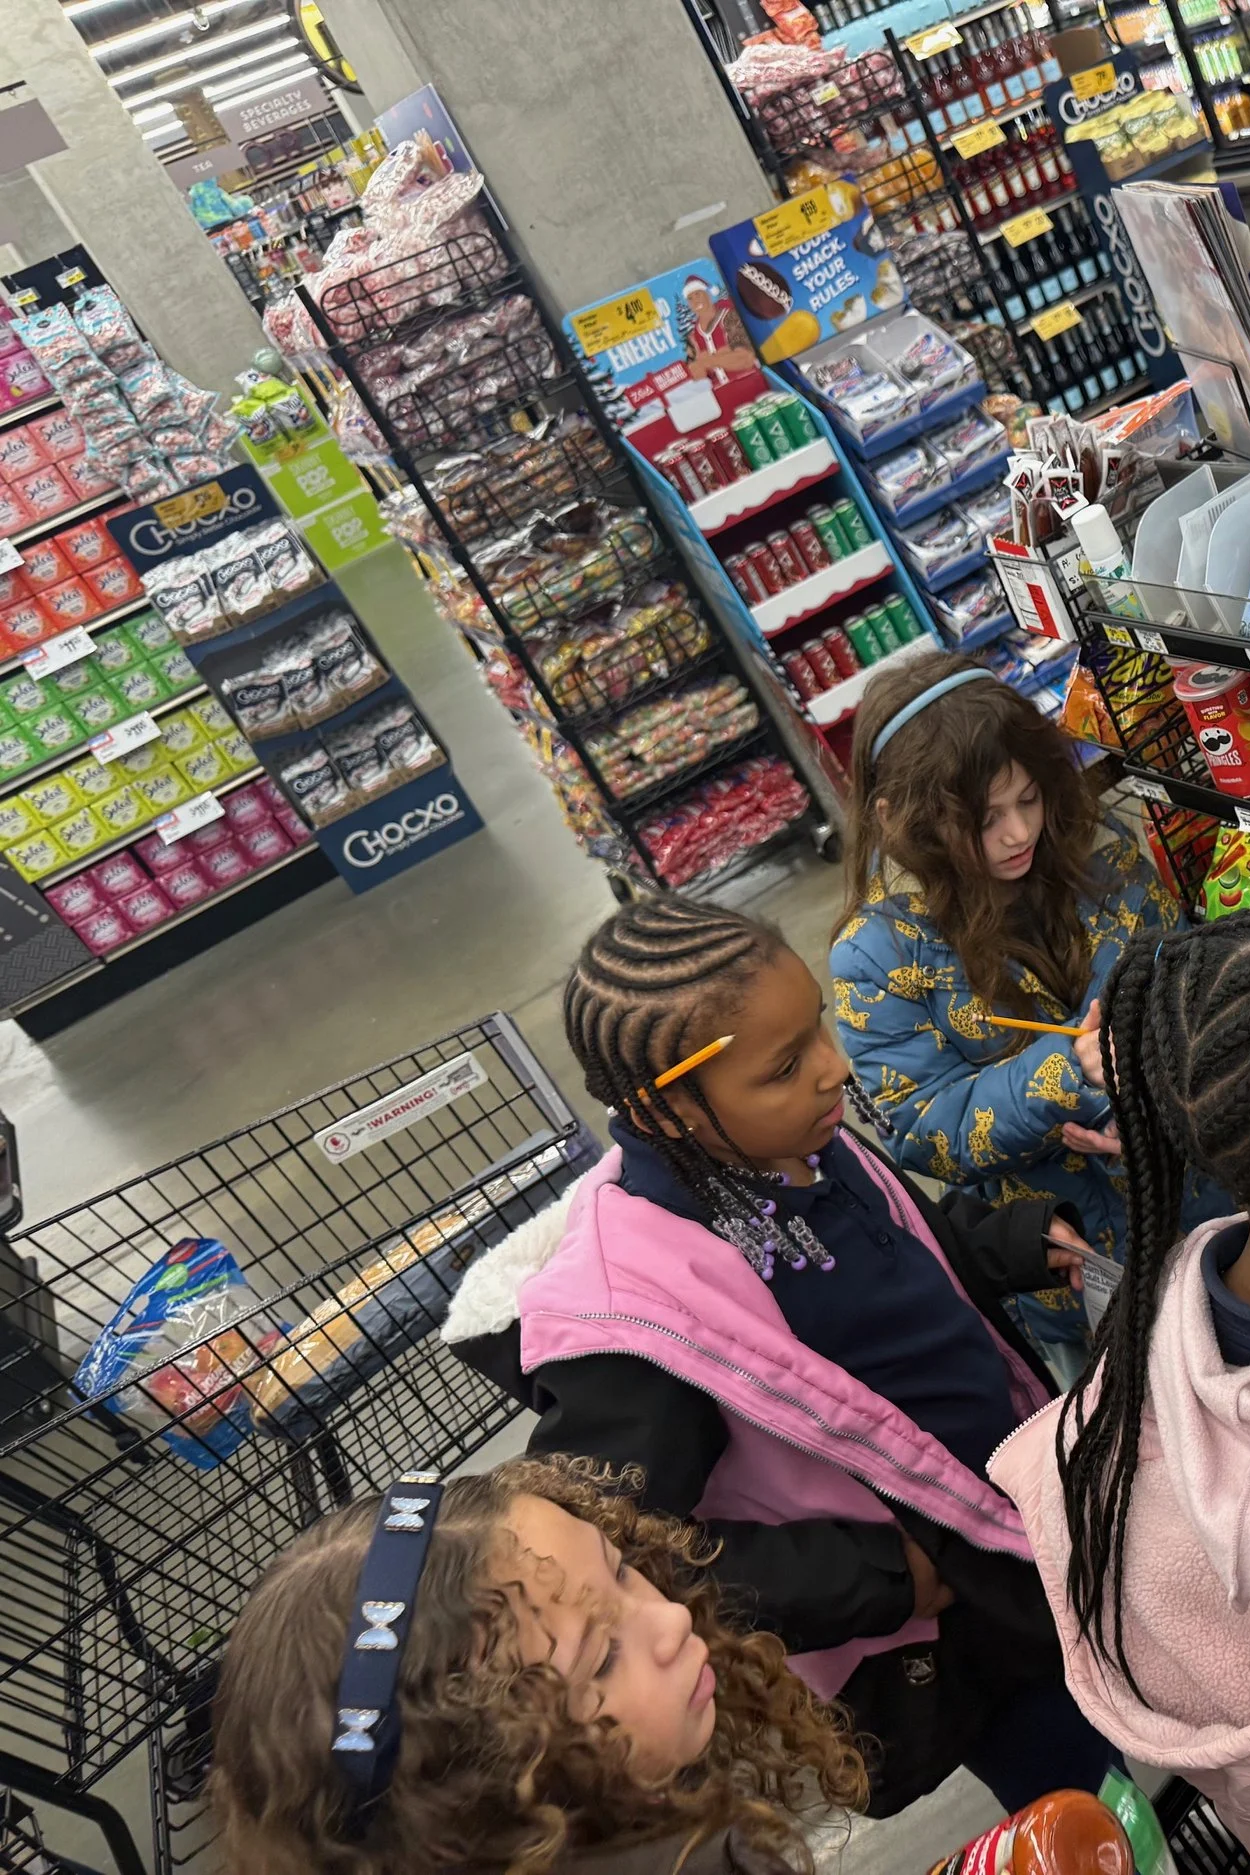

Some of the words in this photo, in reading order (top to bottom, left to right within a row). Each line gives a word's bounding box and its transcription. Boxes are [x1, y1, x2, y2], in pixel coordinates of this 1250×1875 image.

[240, 90, 302, 121] SPECIALTY
[243, 100, 312, 133] BEVERAGES
[192, 160, 213, 173] TEA
[792, 237, 847, 281] SNACK.
[803, 256, 846, 292] YOUR
[1093, 194, 1166, 357] CHOCXO
[809, 271, 860, 312] RULES.
[605, 320, 677, 373] ENERGY
[1203, 711, 1226, 722] FLAVOR
[1206, 750, 1242, 767] PRINGLES
[343, 793, 459, 868] CHOCXO
